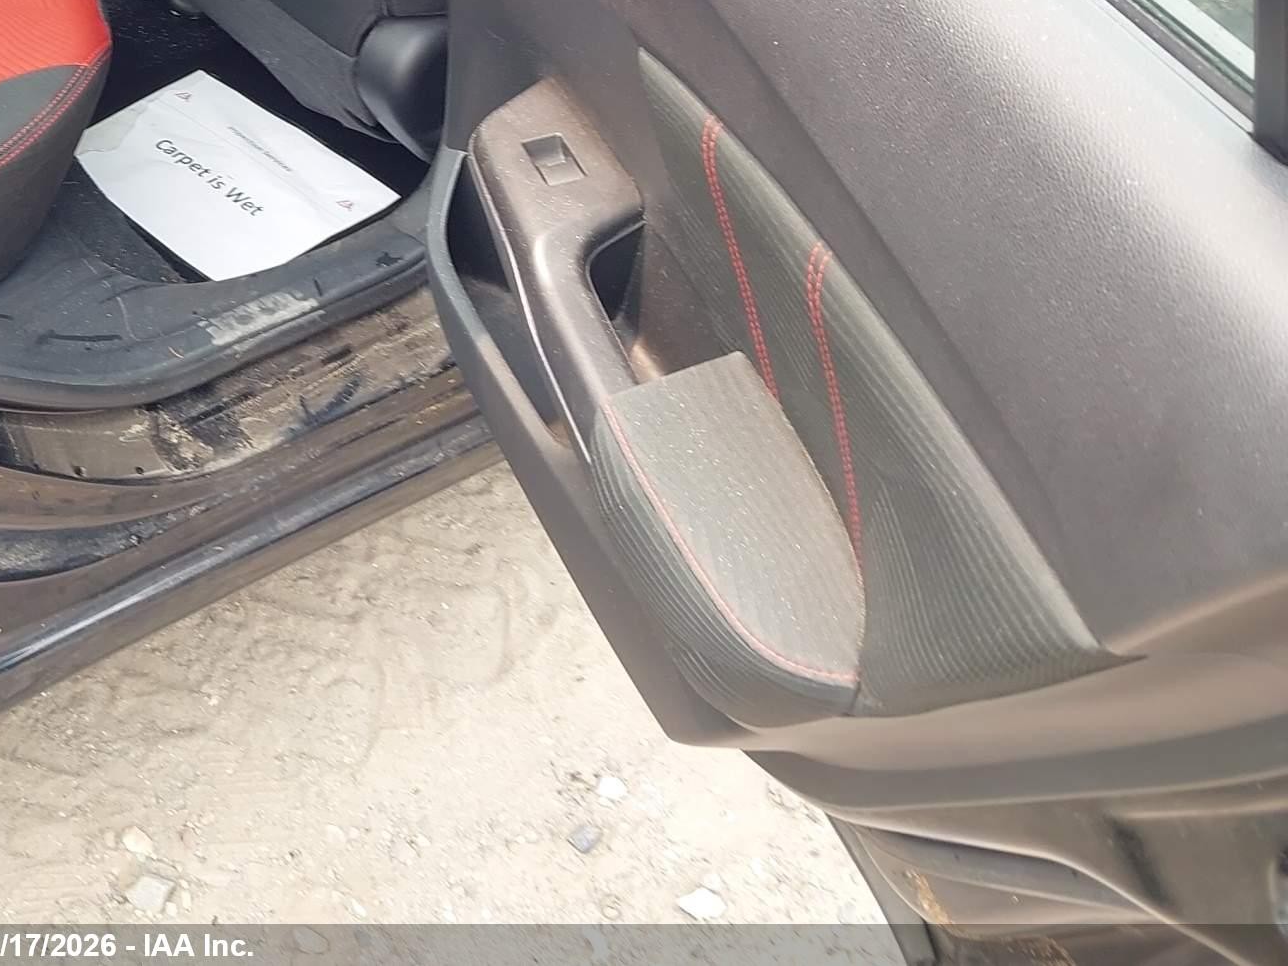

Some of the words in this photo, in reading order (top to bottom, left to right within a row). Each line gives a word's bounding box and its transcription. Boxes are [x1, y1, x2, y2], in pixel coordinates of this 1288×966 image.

[155, 139, 211, 178] Carpet
[206, 175, 227, 190] is
[225, 187, 263, 216] Wet
